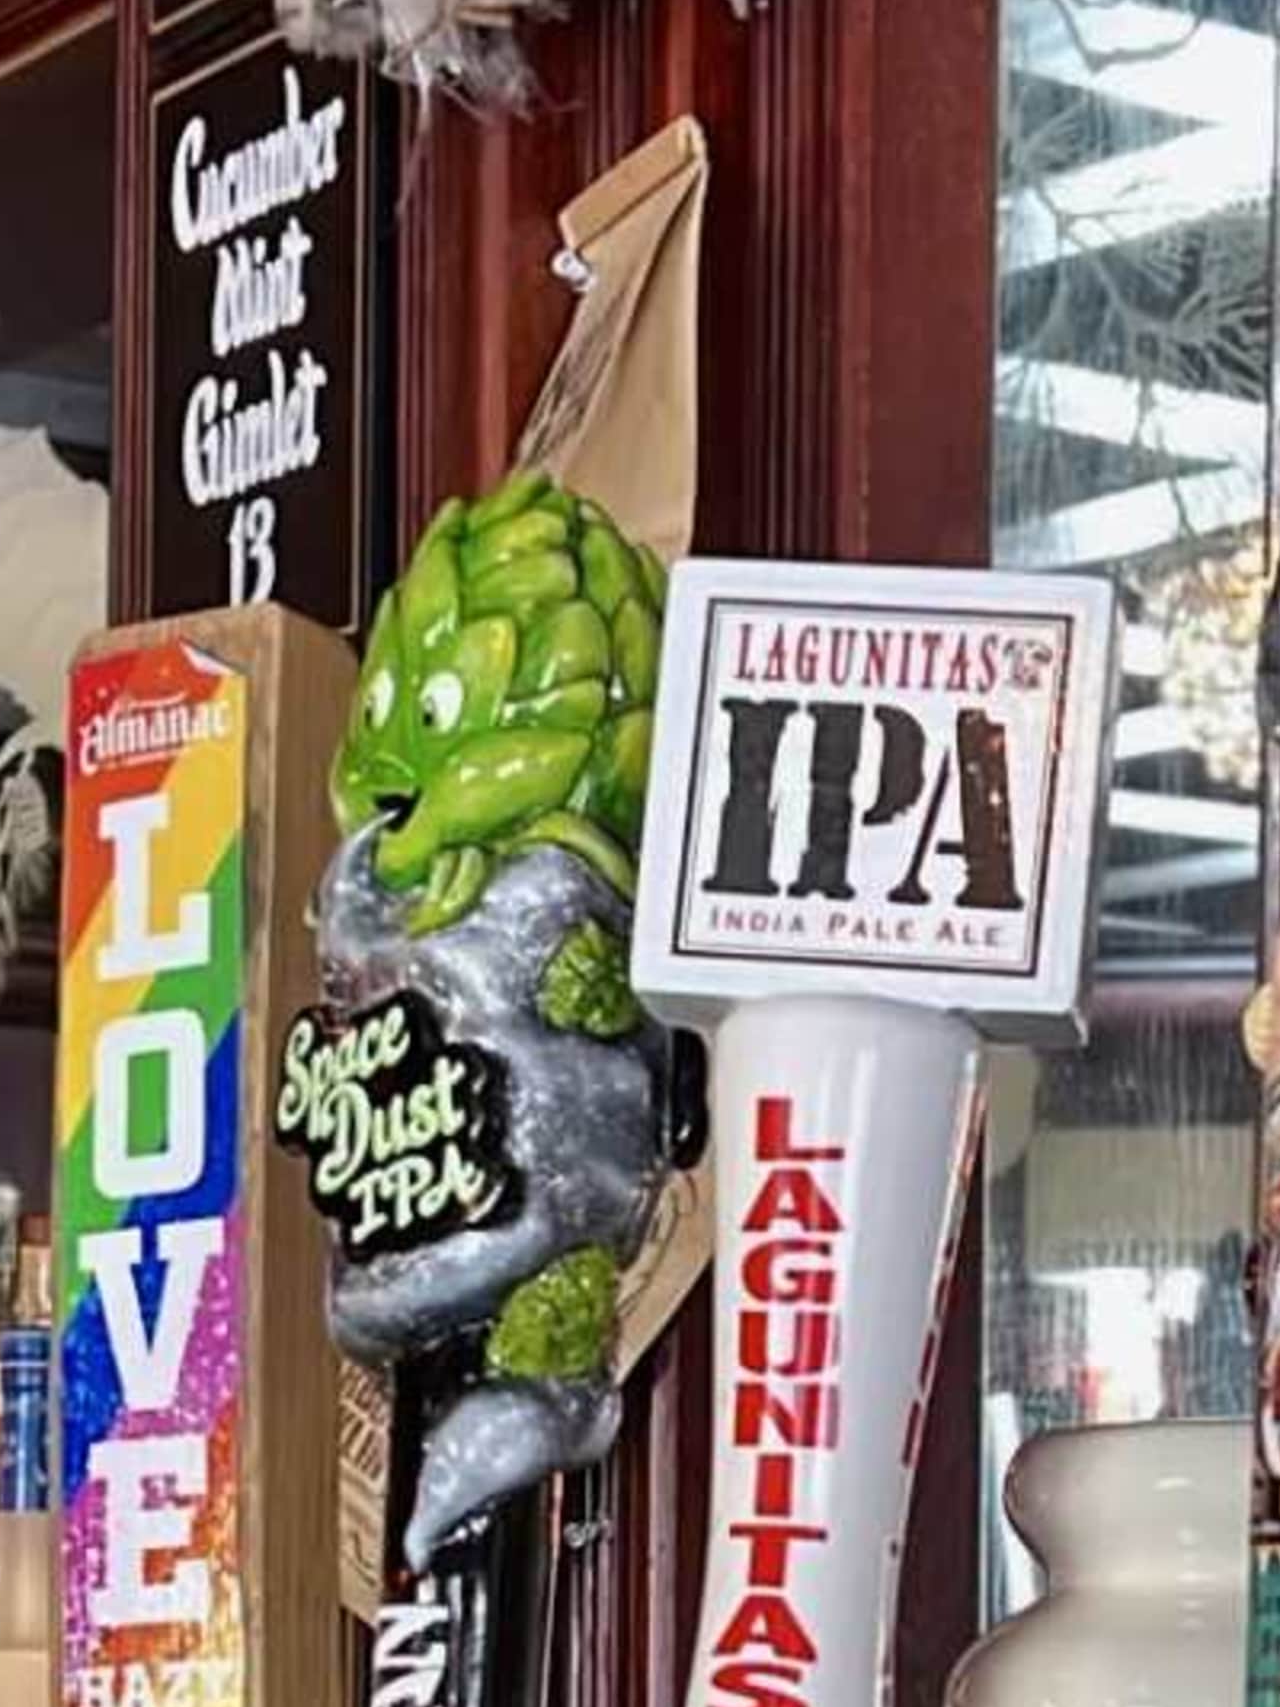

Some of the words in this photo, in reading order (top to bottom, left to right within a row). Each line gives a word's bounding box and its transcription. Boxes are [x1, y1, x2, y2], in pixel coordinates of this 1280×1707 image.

[171, 65, 346, 254] Cucumber
[211, 216, 313, 357] Mint
[182, 348, 328, 507] Gimlet
[227, 496, 277, 607] 13
[733, 621, 1001, 695] LAGUNITAS
[77, 694, 233, 776] Almanac
[700, 694, 1026, 911] IPA
[708, 906, 806, 934] INDIA
[826, 911, 920, 945] PALE
[934, 917, 1006, 950] ALE
[276, 1005, 412, 1143] Space
[315, 1056, 469, 1194] Dust
[78, 795, 224, 1625] LOVE
[347, 1142, 486, 1244] IPA
